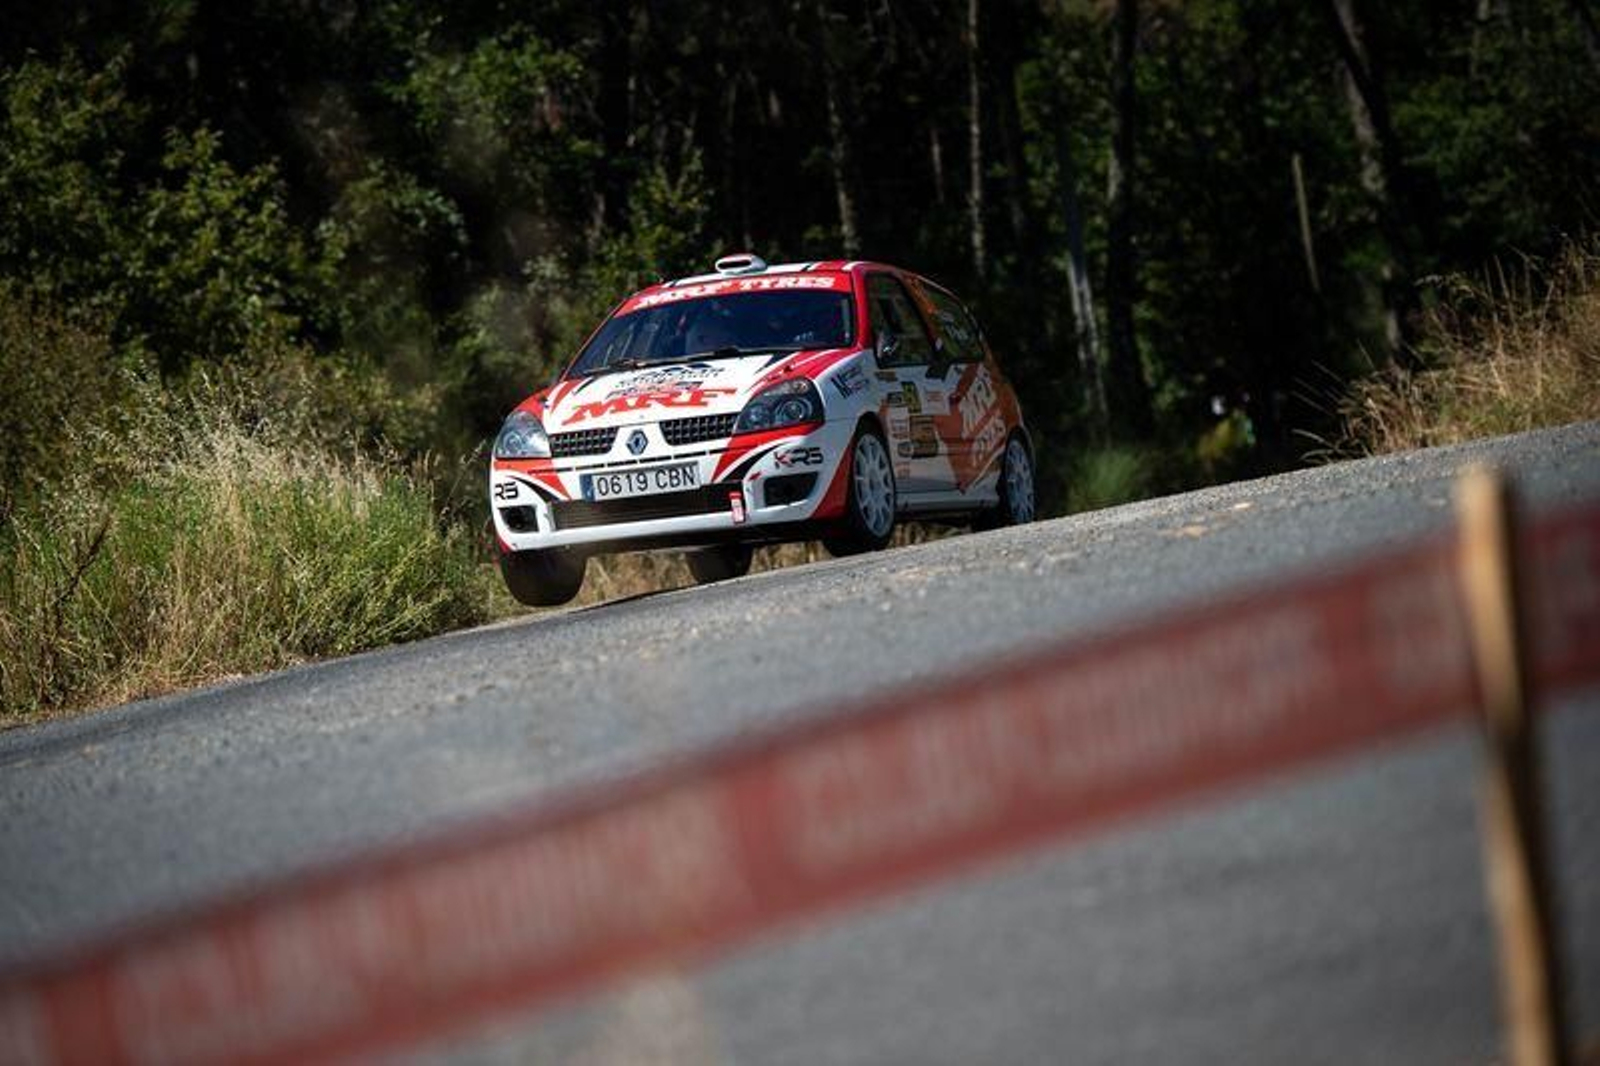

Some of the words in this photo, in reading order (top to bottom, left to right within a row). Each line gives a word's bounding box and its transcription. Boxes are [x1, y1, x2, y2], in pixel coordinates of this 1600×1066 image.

[634, 282, 731, 309] MRF
[740, 276, 835, 291] TYRES
[562, 388, 737, 425] MRF
[774, 447, 823, 469] KRS
[494, 481, 519, 500] RS
[597, 472, 648, 496] 0619
[655, 465, 695, 488] CBN
